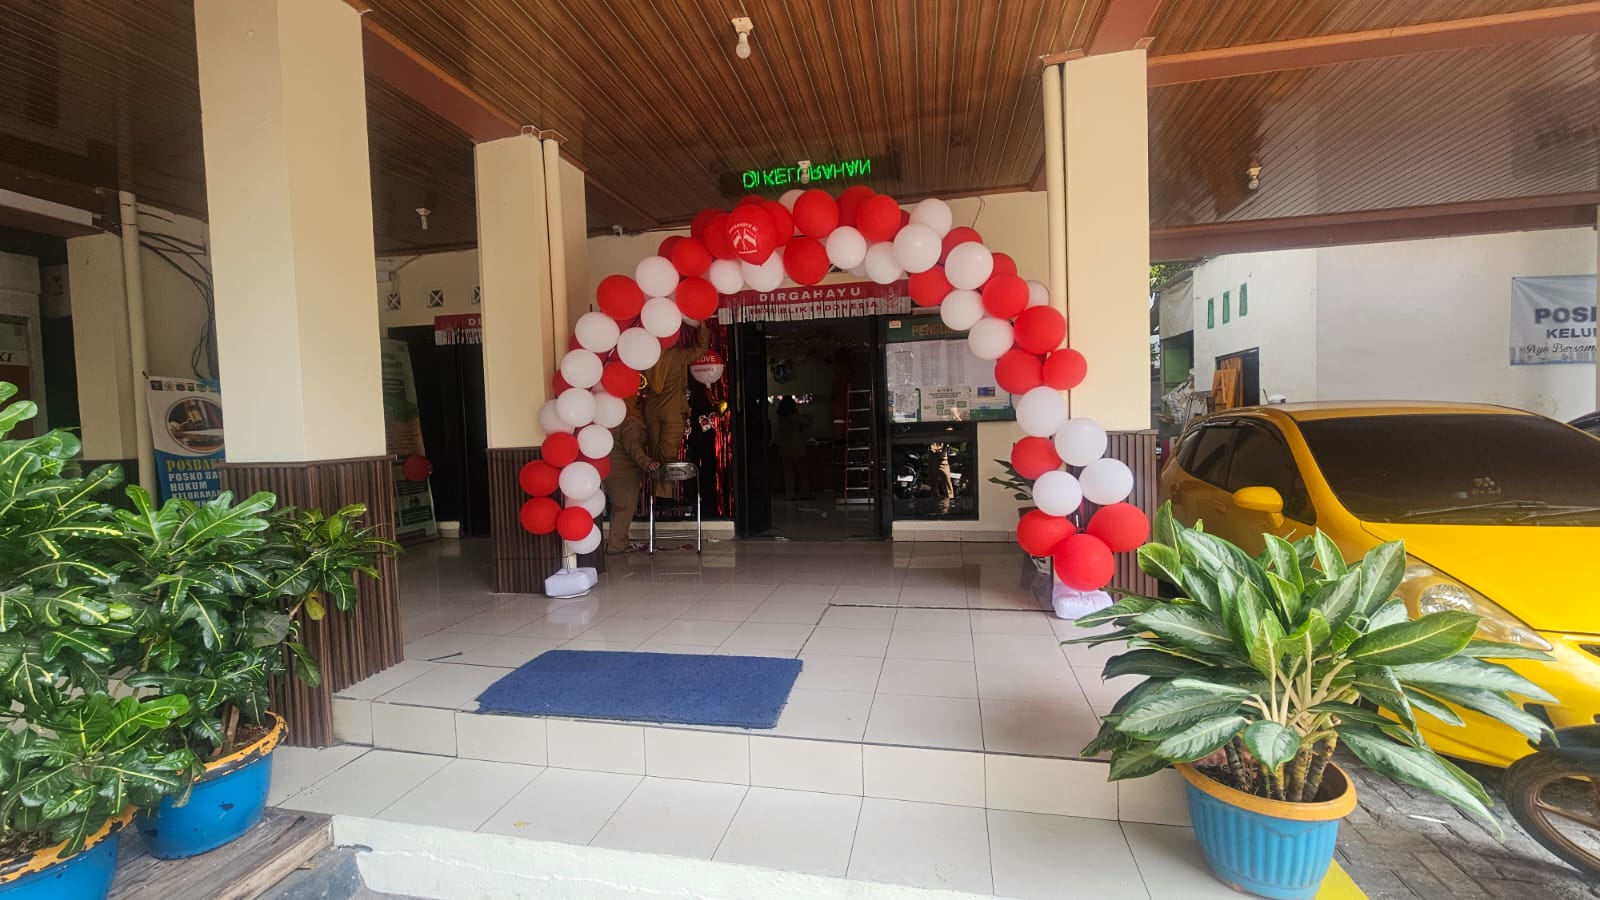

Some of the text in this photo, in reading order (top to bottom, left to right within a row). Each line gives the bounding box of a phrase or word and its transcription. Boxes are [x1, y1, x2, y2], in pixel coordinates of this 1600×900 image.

[759, 287, 861, 302] DIRGAHAYU
[1546, 328, 1597, 339] KELU
[1552, 342, 1597, 353] Bersam
[168, 472, 203, 482] POSKO
[170, 481, 208, 492] HUKUM
